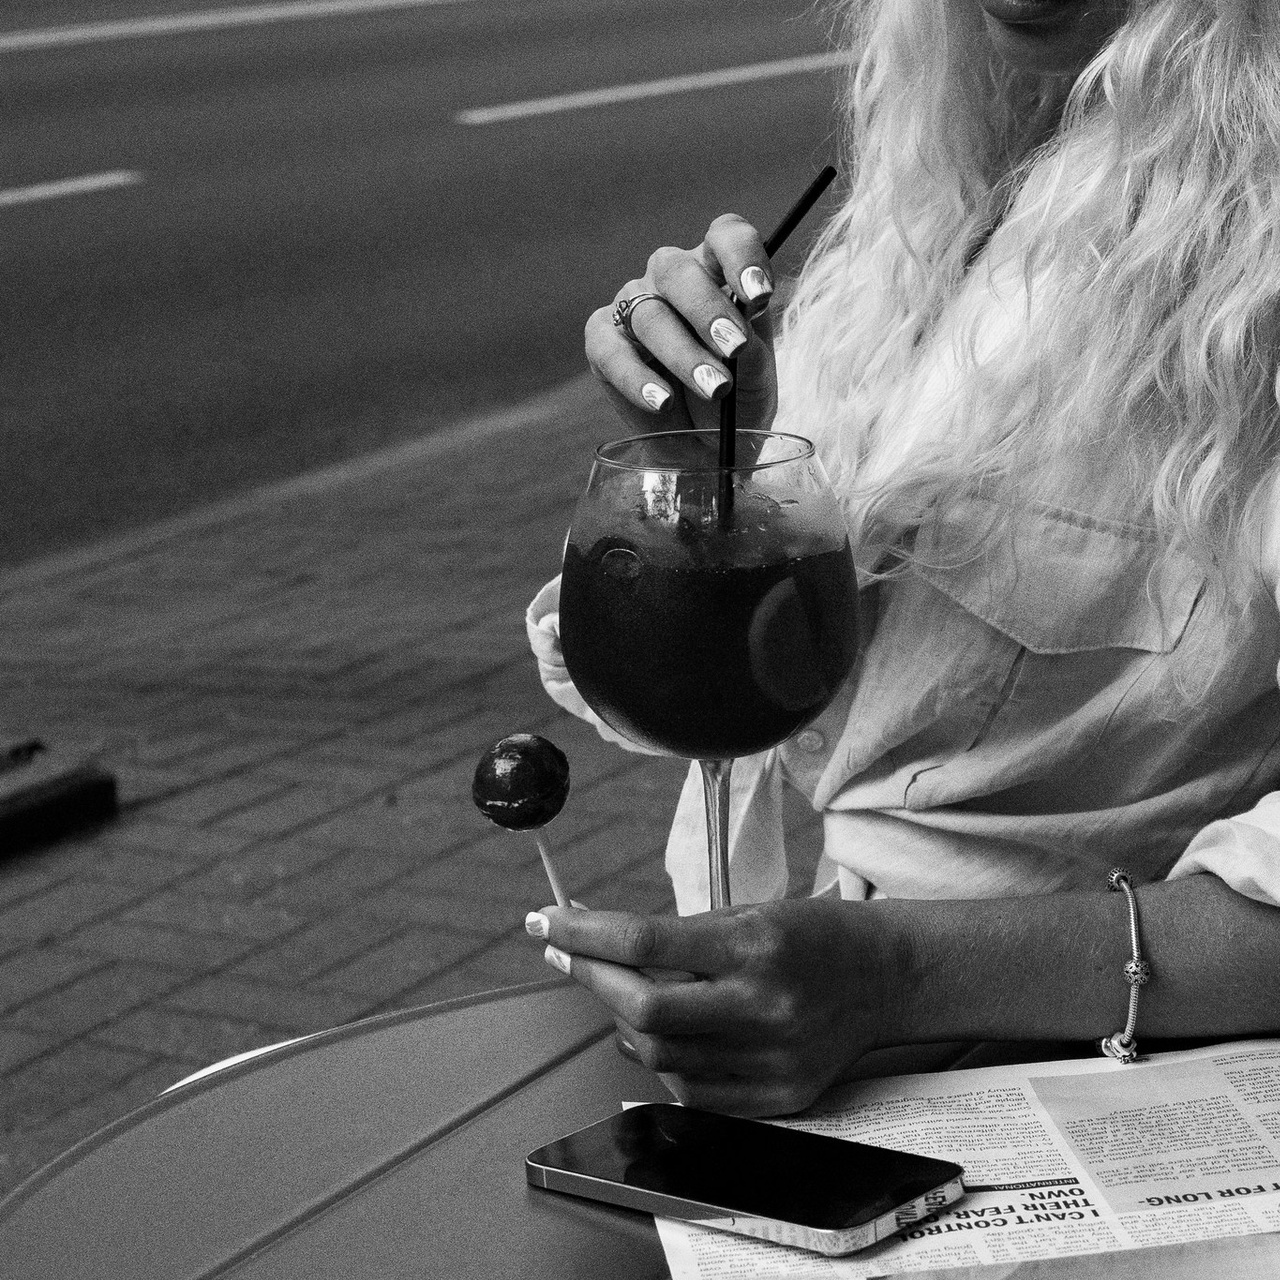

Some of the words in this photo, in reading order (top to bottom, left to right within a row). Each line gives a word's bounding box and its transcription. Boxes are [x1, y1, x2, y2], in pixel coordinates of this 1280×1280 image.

[992, 1178, 1075, 1191] INTERNATIONAL
[1216, 1184, 1267, 1198] FOR
[1019, 1187, 1085, 1201] OWN.
[1137, 1191, 1213, 1206] LONG-
[1020, 1197, 1094, 1211] THEIR
[1014, 1210, 1085, 1225] CAN'T
[1090, 1208, 1100, 1217] I
[895, 1217, 1008, 1242] CONTROL
